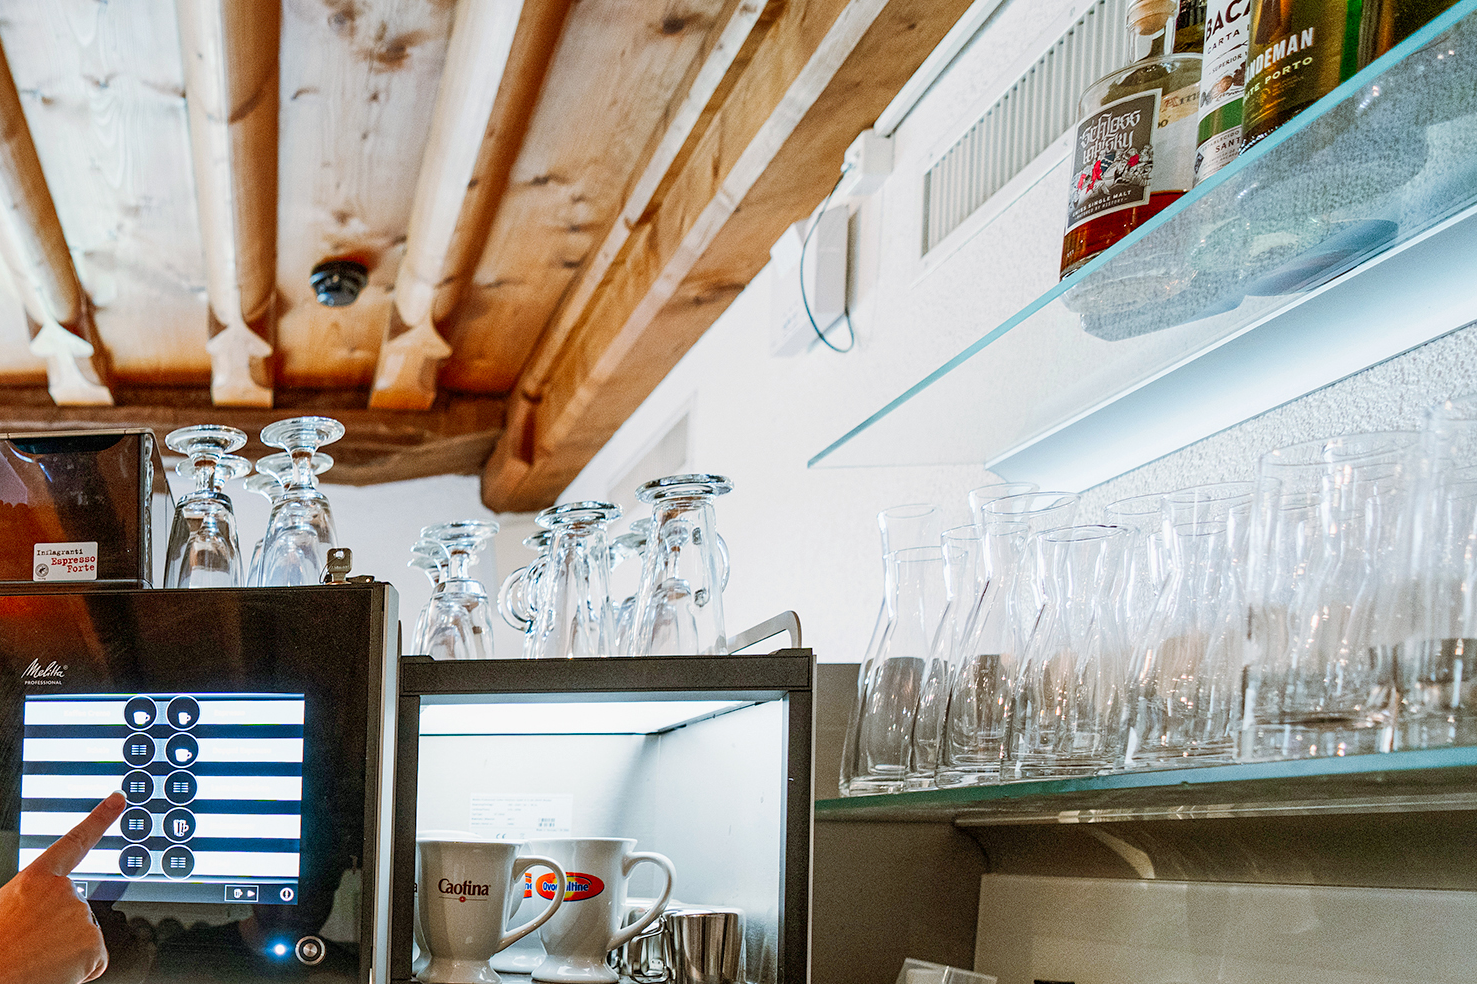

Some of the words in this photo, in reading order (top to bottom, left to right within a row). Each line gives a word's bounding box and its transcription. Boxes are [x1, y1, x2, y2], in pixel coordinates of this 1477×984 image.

[1265, 56, 1314, 85] PORTO
[1112, 189, 1132, 200] MALT
[51, 555, 96, 567] Espresso
[67, 563, 95, 574] Forte
[21, 657, 65, 679] Melitta
[438, 878, 489, 896] Caotina
[542, 881, 589, 892] Ovoltine
